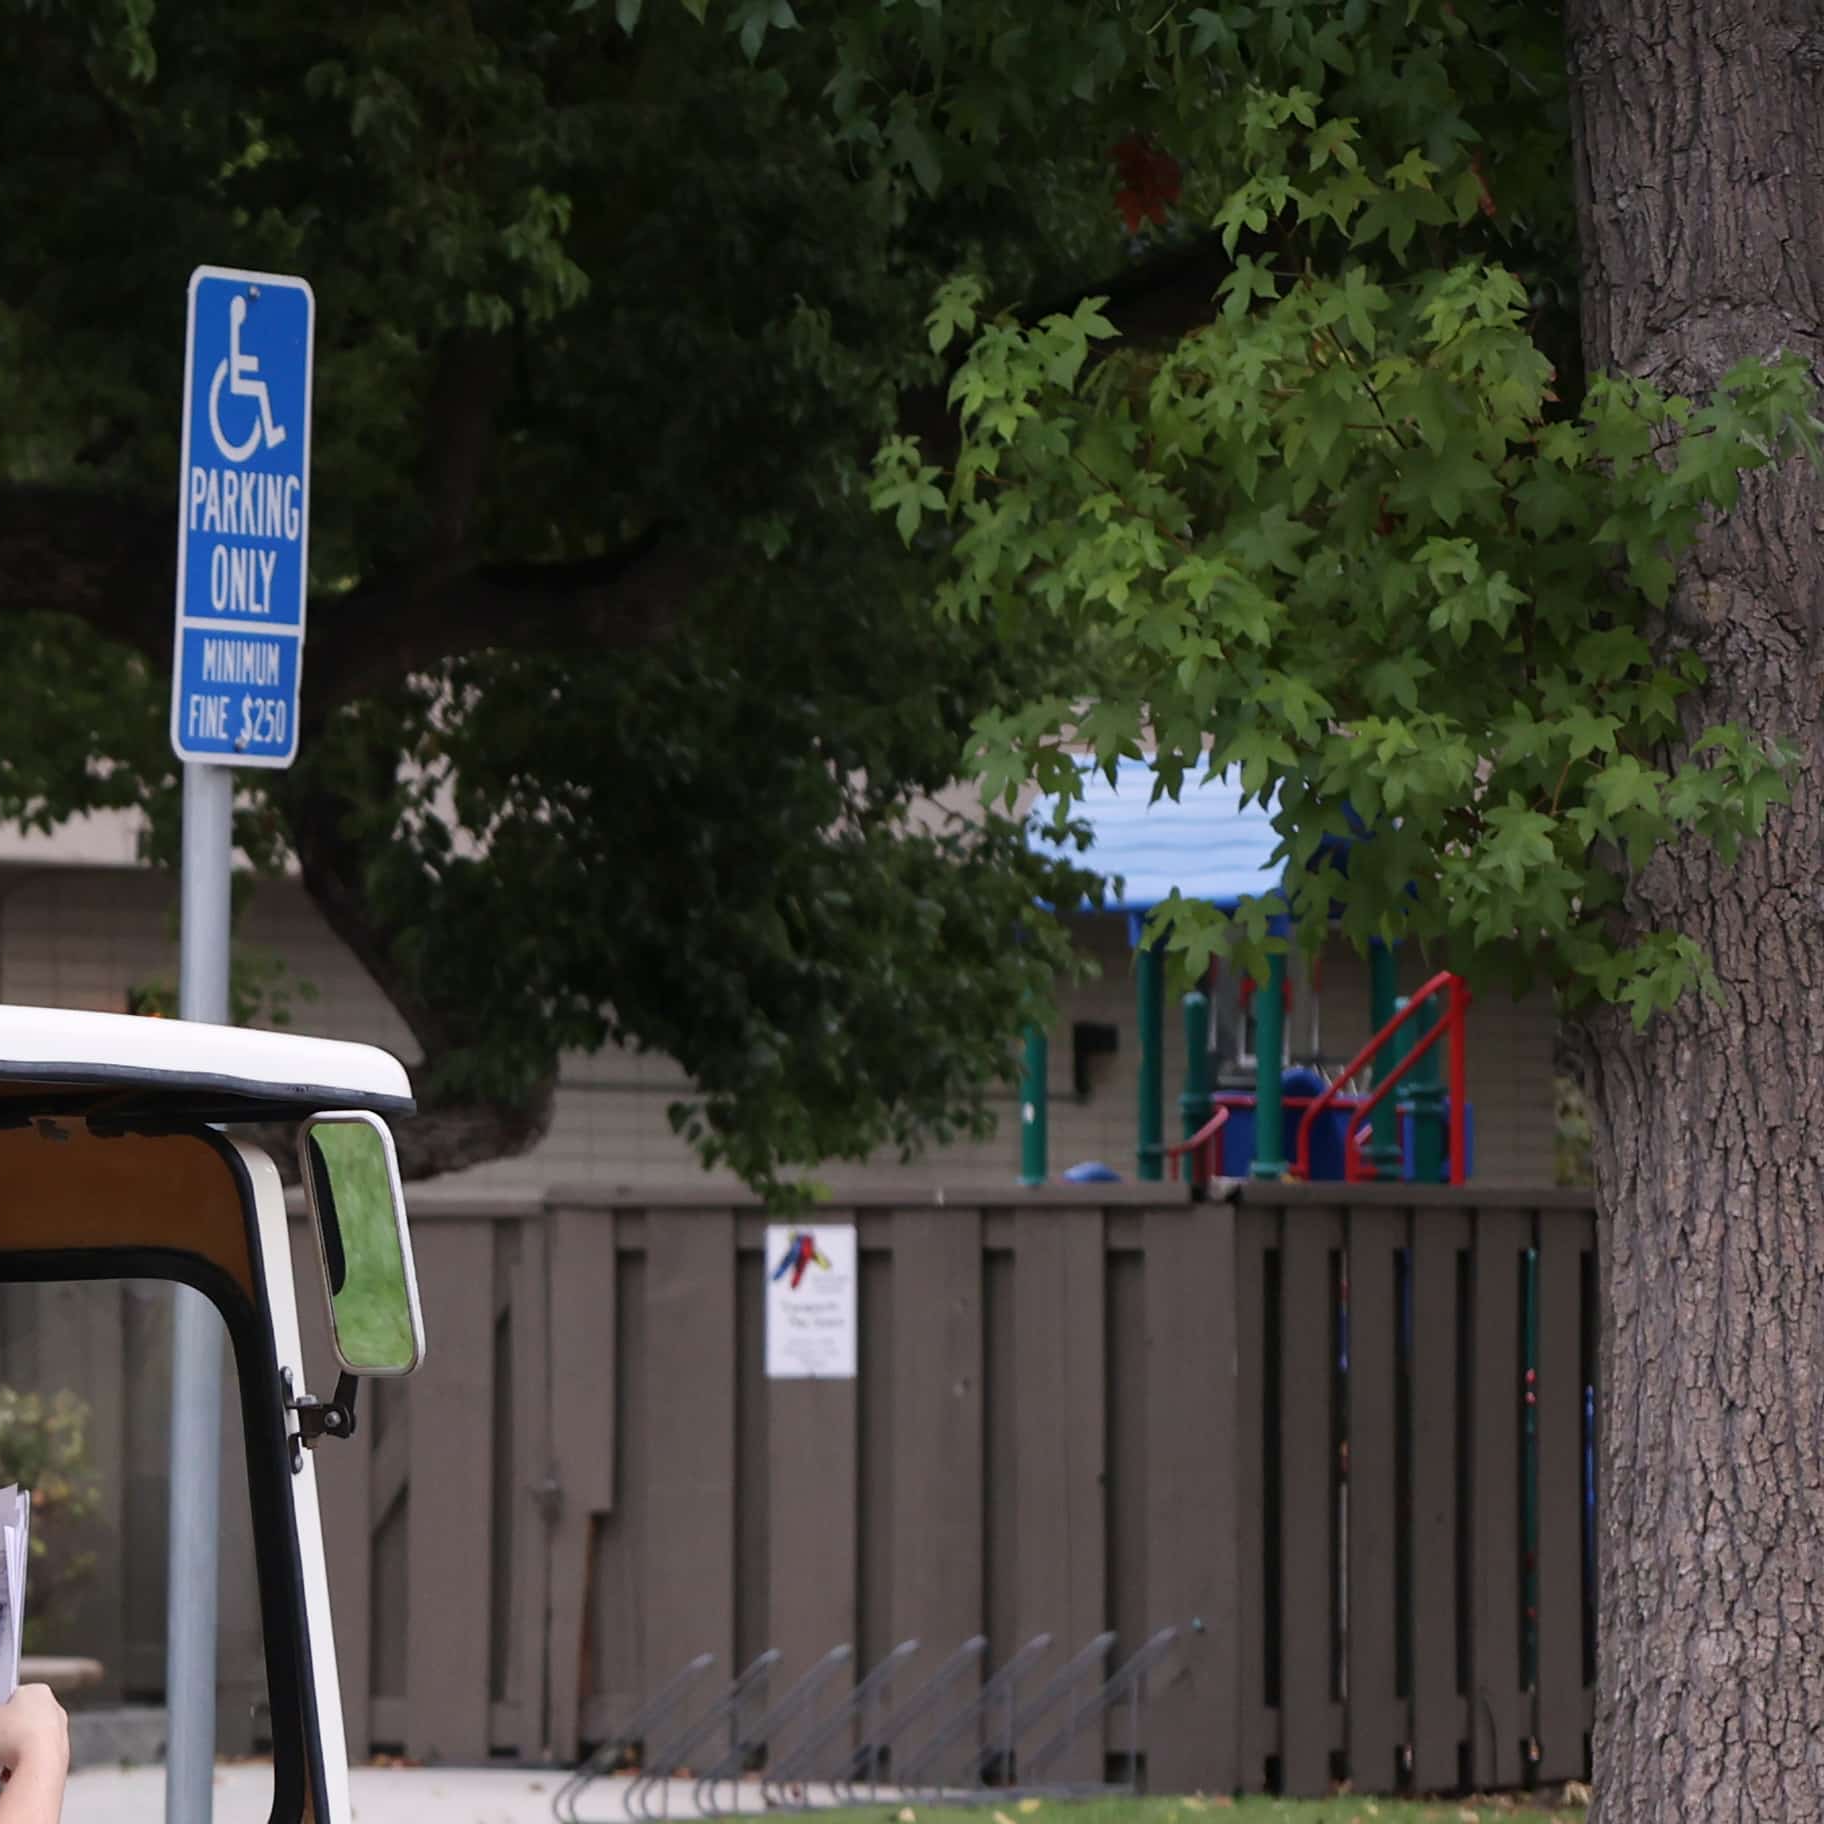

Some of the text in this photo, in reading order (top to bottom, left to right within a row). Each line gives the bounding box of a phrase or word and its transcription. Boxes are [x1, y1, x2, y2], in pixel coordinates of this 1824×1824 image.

[190, 466, 300, 540] PARKING
[211, 545, 276, 614] ONLY
[203, 638, 280, 686] MINIMUM
[189, 692, 286, 745] FINE $250
